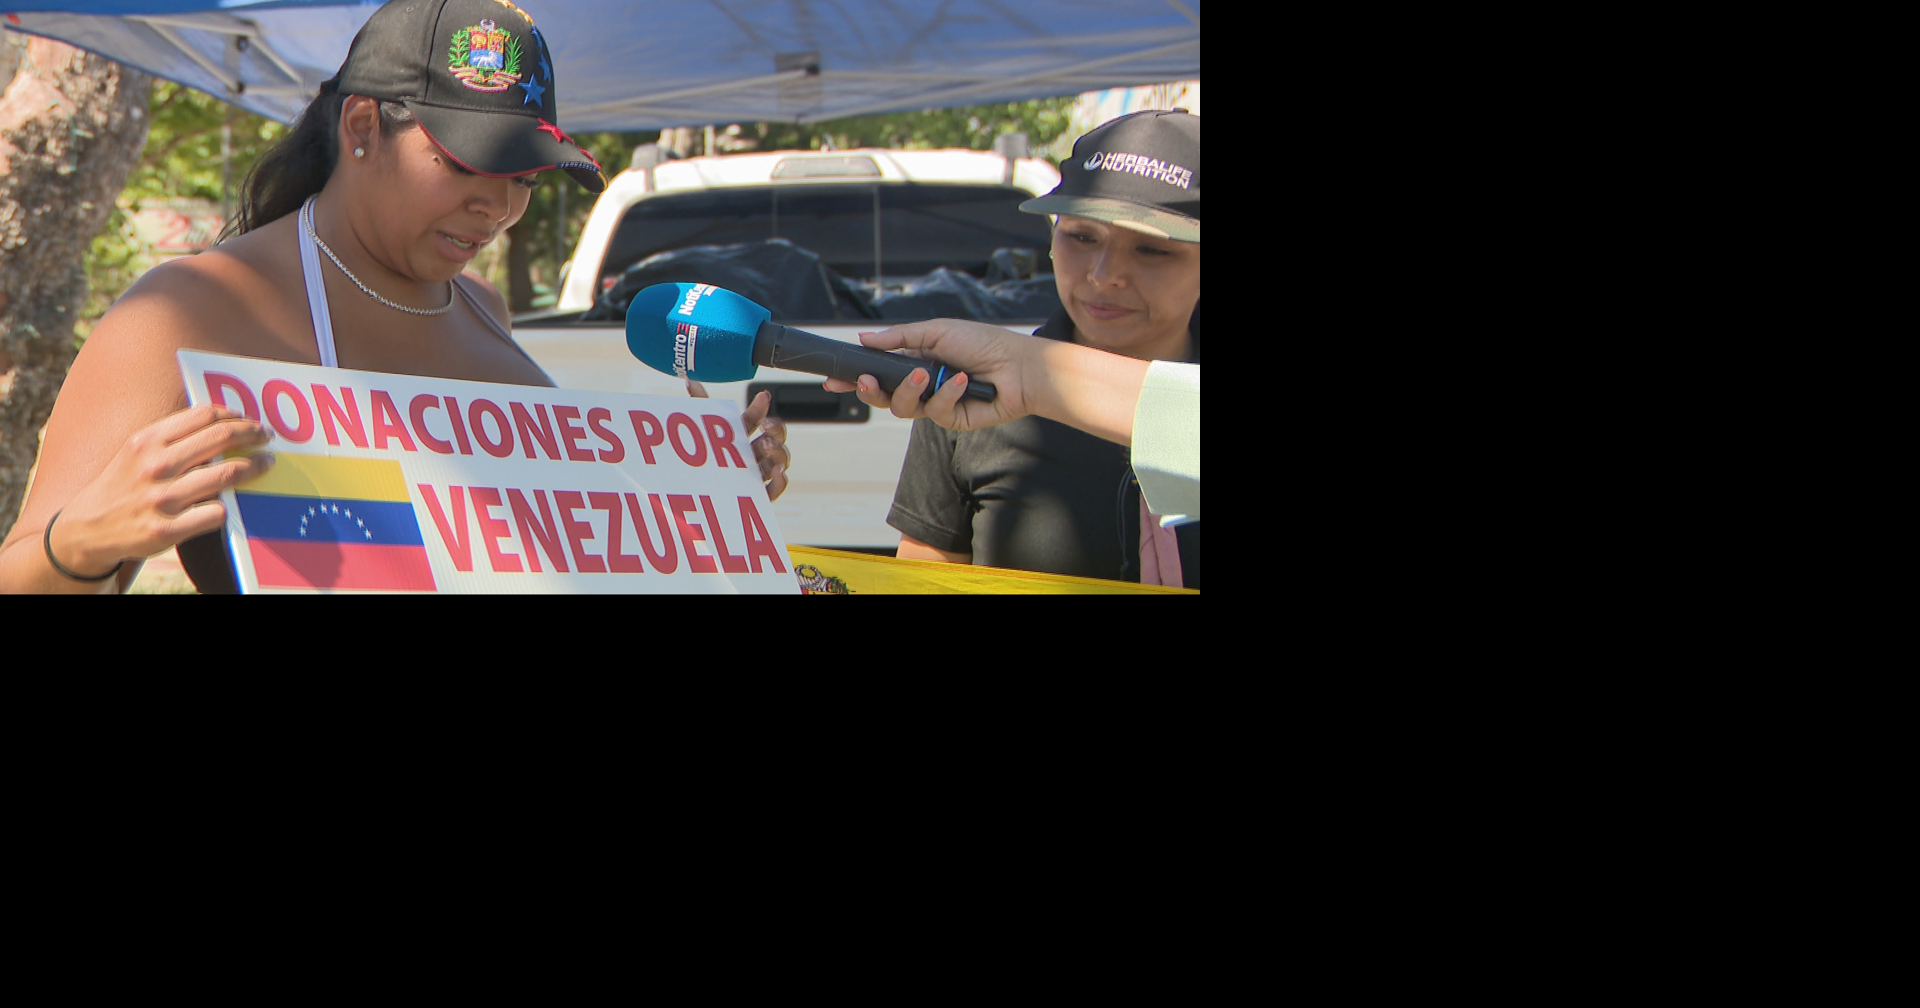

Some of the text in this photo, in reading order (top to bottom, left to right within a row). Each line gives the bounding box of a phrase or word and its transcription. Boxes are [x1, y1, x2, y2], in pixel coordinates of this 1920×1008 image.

[1101, 160, 1190, 190] NUTRITION
[1105, 152, 1193, 179] HERBALIFE
[203, 370, 748, 468] DONACIONES POR
[417, 483, 788, 575] VENEZUELA
